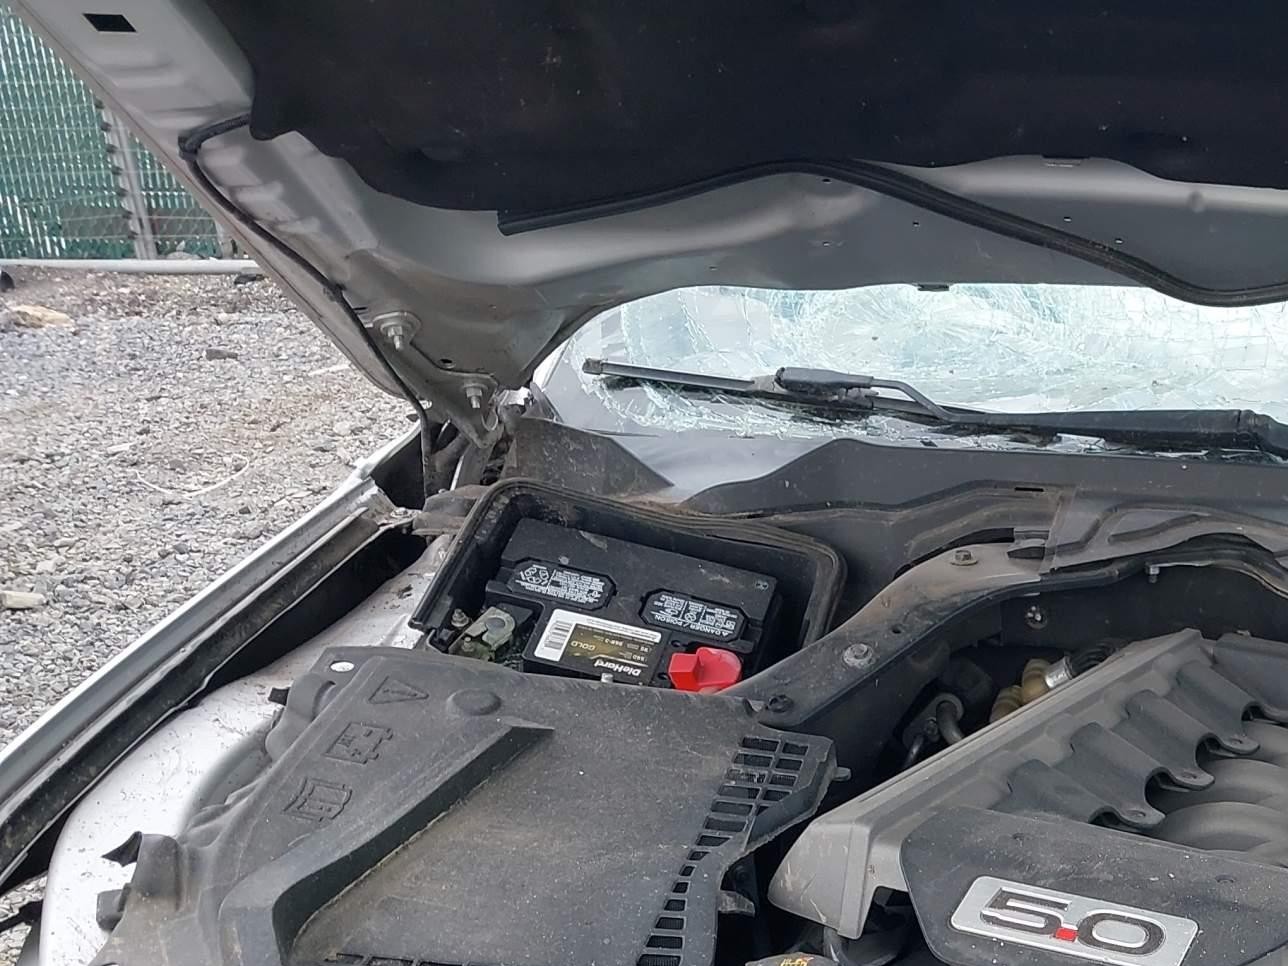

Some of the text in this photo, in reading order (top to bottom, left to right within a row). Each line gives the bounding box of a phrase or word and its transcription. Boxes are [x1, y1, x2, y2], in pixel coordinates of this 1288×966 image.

[655, 614, 683, 626] POISON
[690, 622, 721, 636] DANGER
[570, 640, 596, 651] GOLD
[594, 659, 642, 676] DieHard
[979, 886, 1166, 956] 5.0
